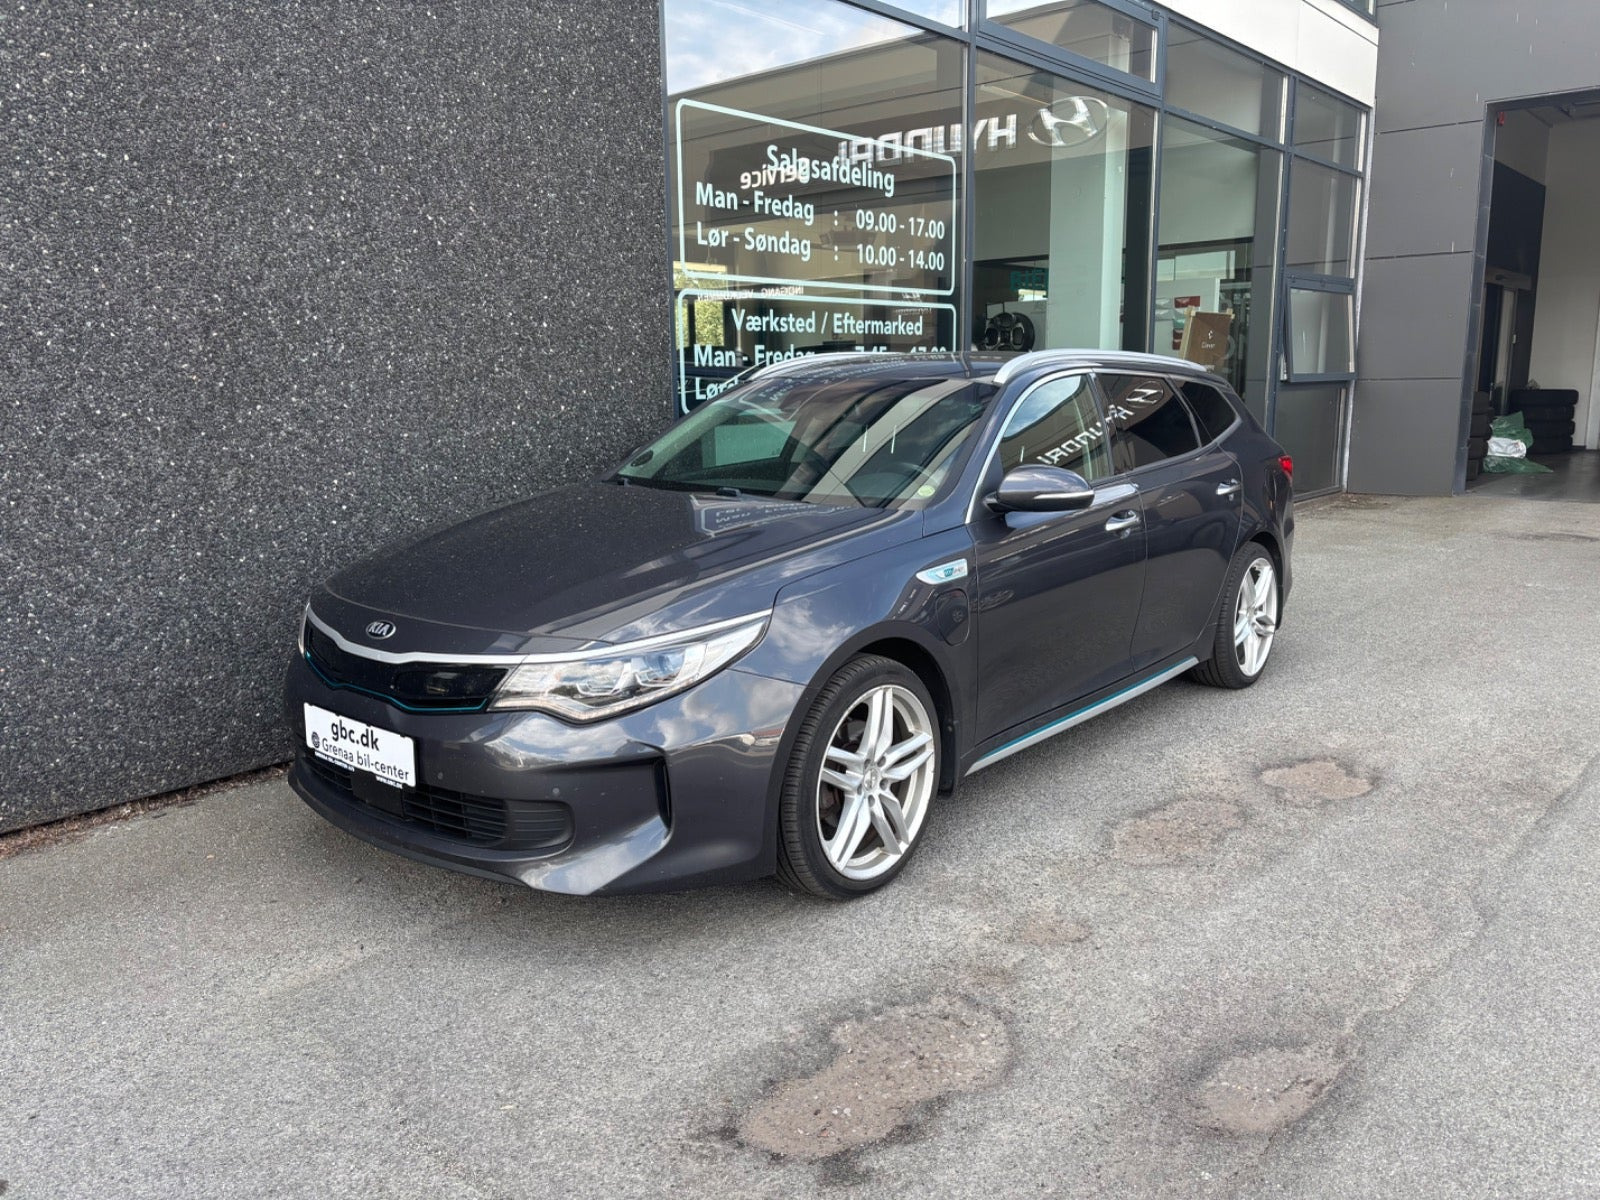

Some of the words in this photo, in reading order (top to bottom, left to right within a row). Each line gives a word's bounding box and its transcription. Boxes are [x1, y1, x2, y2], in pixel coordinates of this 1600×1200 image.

[766, 144, 895, 198] Salgsafdeling
[696, 181, 738, 211] Man
[753, 190, 814, 226] Fredag
[856, 209, 896, 233] 09.00
[908, 216, 945, 240] 17.00
[697, 221, 729, 248] Lør
[744, 227, 811, 262] Søndag
[856, 243, 896, 266] 10.00
[908, 249, 945, 271] 14.00
[731, 308, 816, 333] Værksted
[833, 313, 923, 336] Eftermarked
[694, 343, 736, 367] Man
[369, 621, 391, 636] KIA
[331, 719, 380, 751] gbc.dk
[322, 737, 354, 762] Grenaa
[357, 750, 409, 781] bil-center
